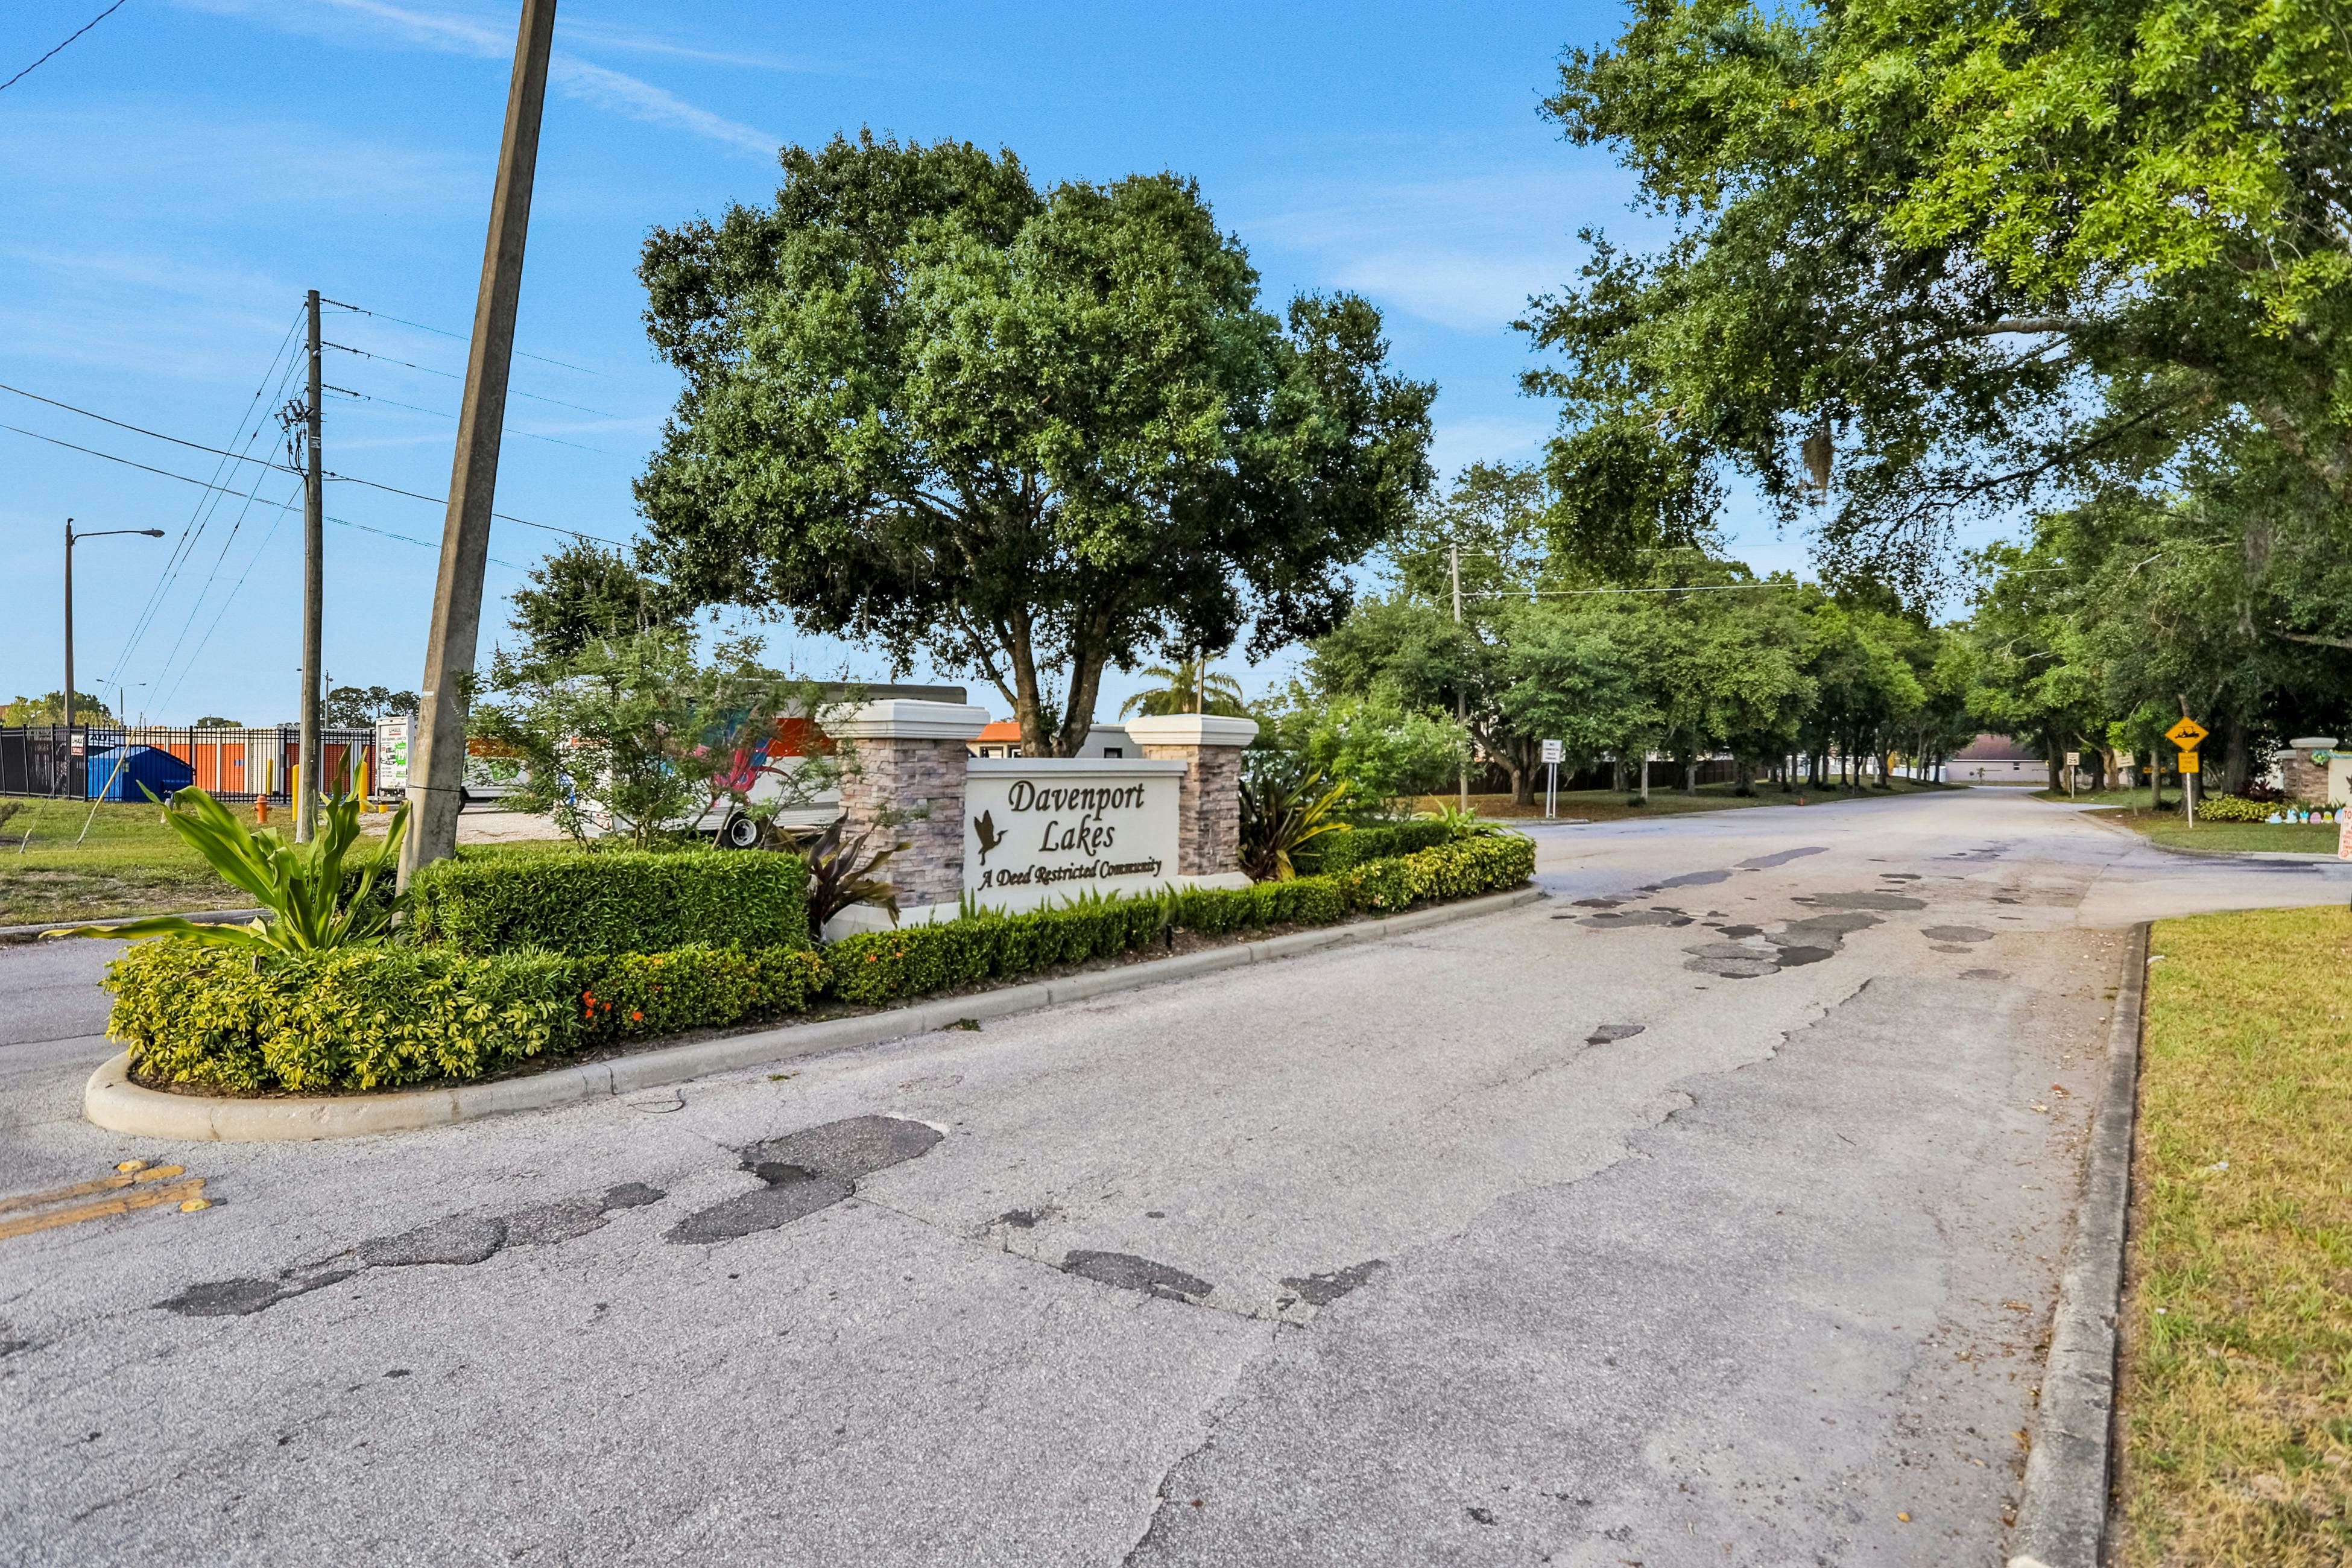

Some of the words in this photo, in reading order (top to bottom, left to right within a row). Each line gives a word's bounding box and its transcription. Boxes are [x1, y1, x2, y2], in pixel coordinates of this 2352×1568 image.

[1008, 780, 1145, 821] Davenport
[1038, 814, 1115, 856] Lakes
[978, 869, 993, 891] A
[996, 865, 1035, 886] Deed
[1034, 859, 1101, 885] Restricted
[1099, 856, 1162, 879] Community
